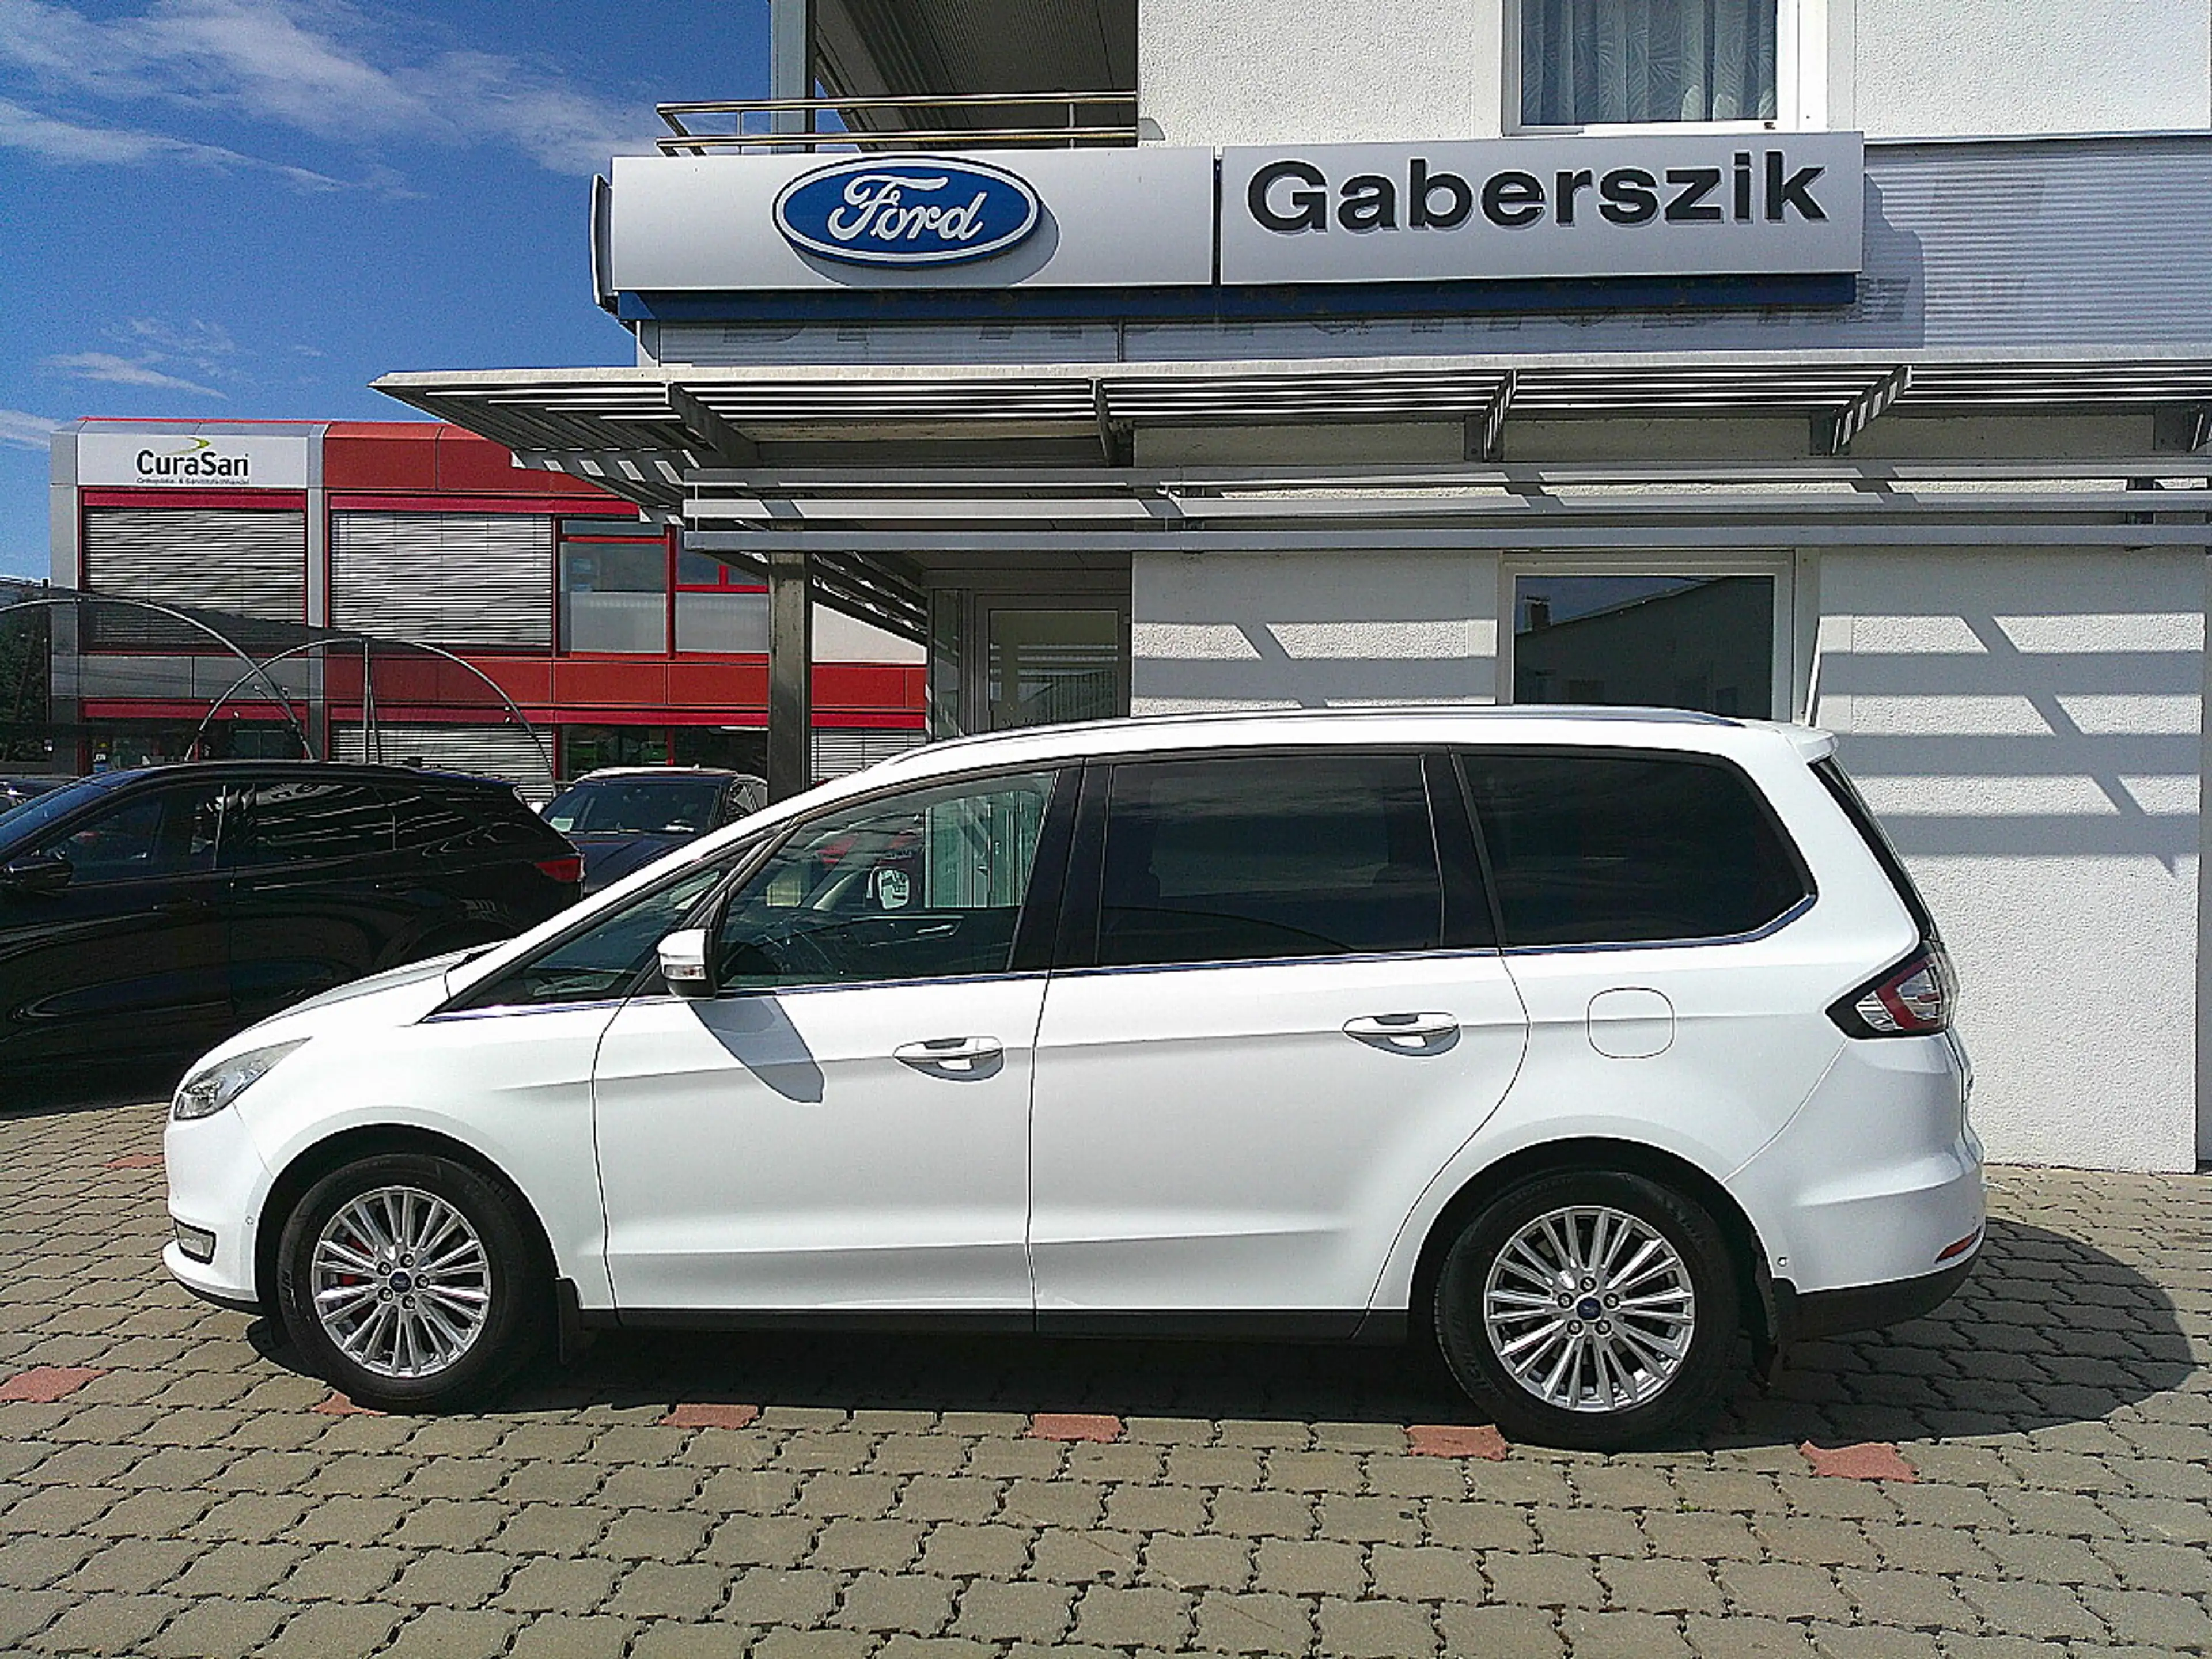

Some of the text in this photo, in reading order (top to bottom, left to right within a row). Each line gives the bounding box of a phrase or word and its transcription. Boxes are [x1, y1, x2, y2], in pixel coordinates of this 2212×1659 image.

[827, 175, 988, 241] Ford
[1248, 150, 1828, 232] Gaberszik
[137, 450, 248, 476] CuraSan
